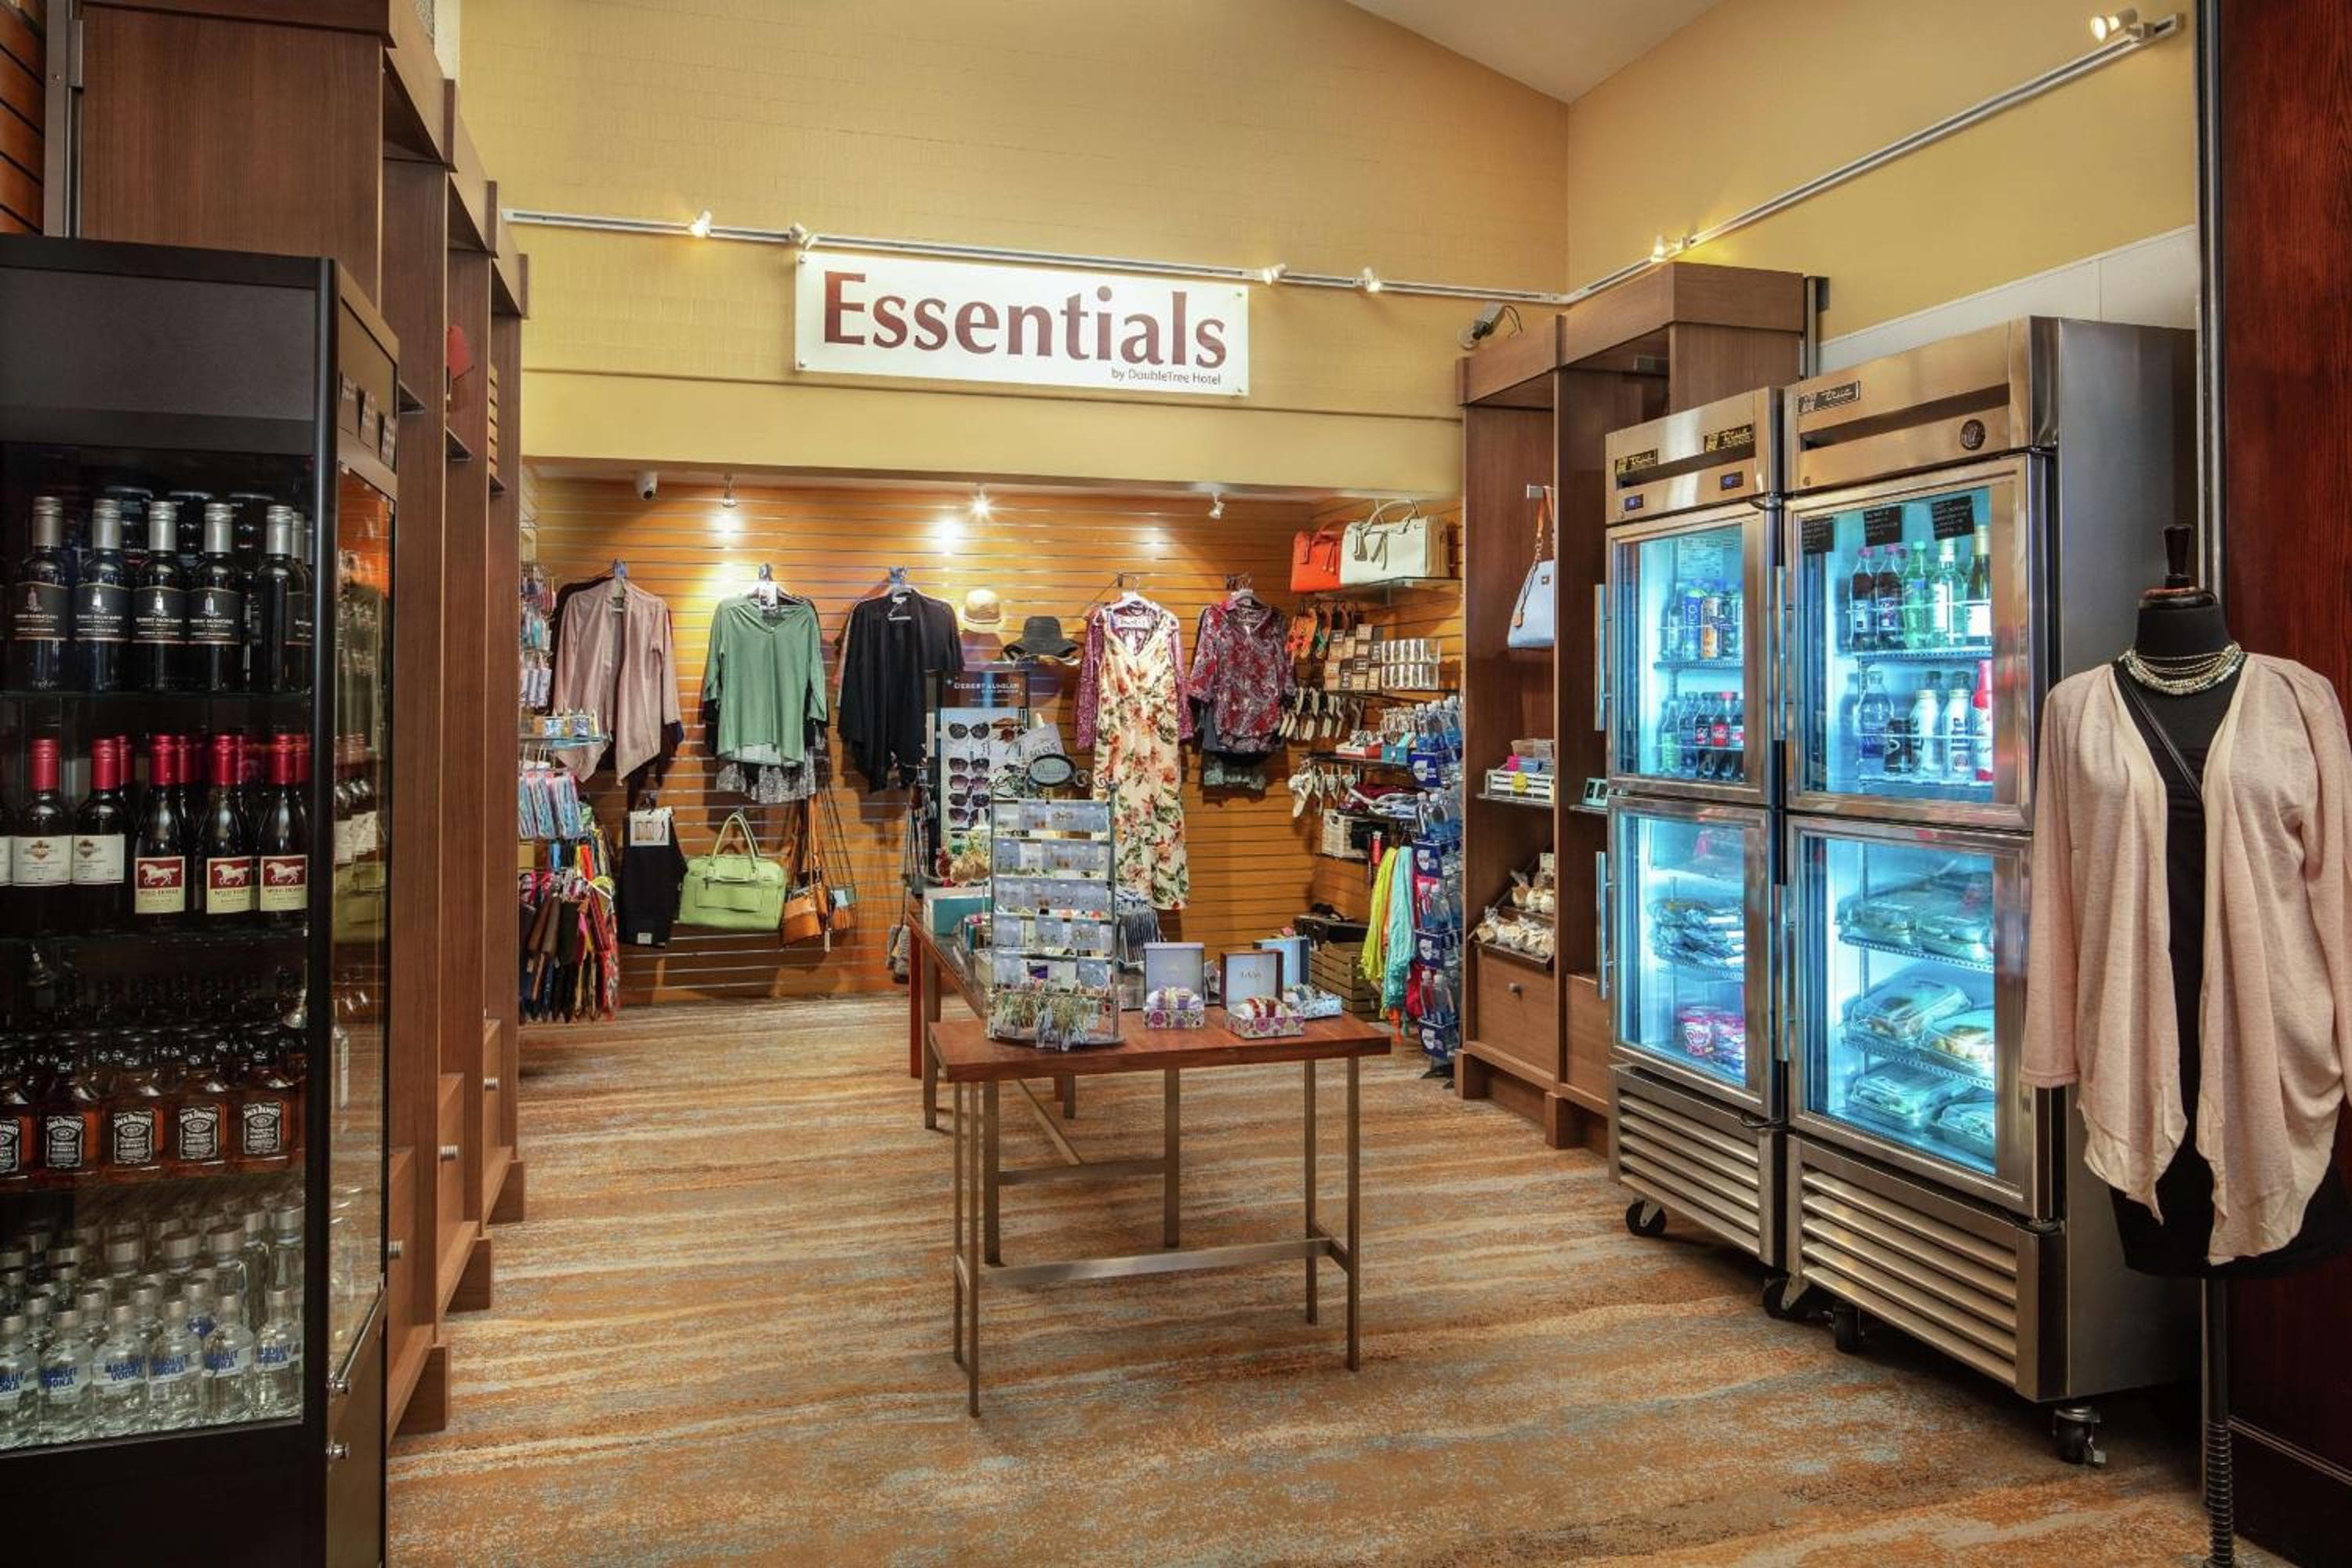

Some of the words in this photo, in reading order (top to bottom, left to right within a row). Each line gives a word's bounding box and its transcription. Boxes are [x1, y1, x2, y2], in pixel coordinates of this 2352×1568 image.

[824, 270, 1227, 369] Essentials
[1111, 368, 1125, 381] by
[1128, 368, 1190, 384] DoubleTree
[1192, 372, 1221, 385] Hotel
